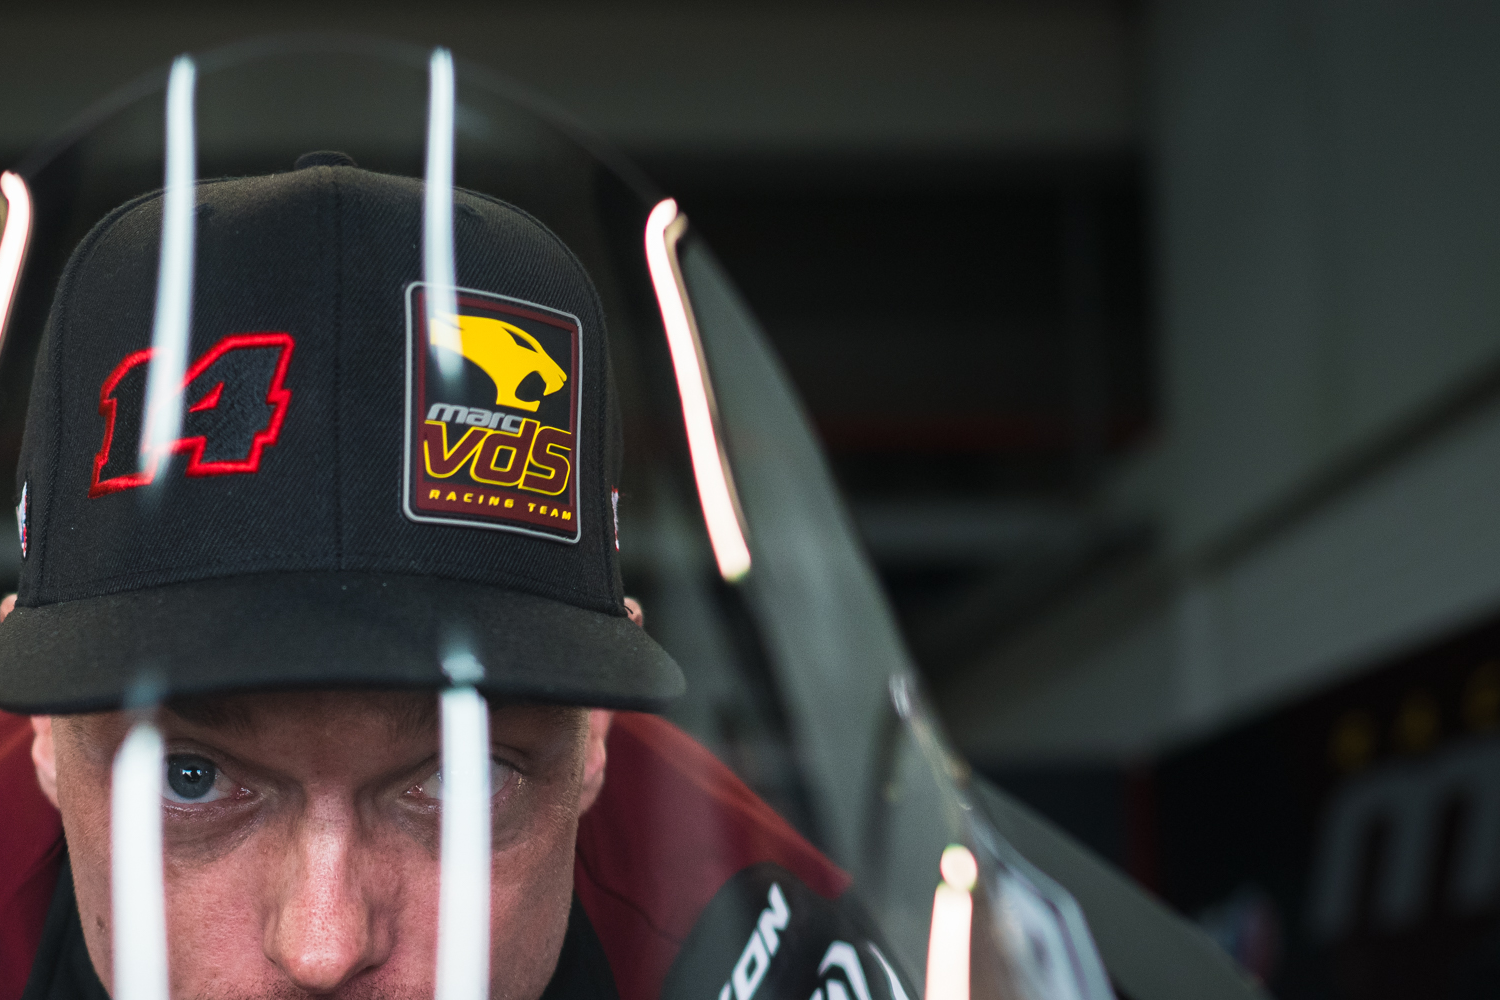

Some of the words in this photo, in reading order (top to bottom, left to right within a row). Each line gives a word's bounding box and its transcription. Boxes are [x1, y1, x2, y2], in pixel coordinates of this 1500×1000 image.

[88, 331, 296, 498] 14
[429, 490, 515, 508] RACING
[528, 503, 572, 520] TEAM
